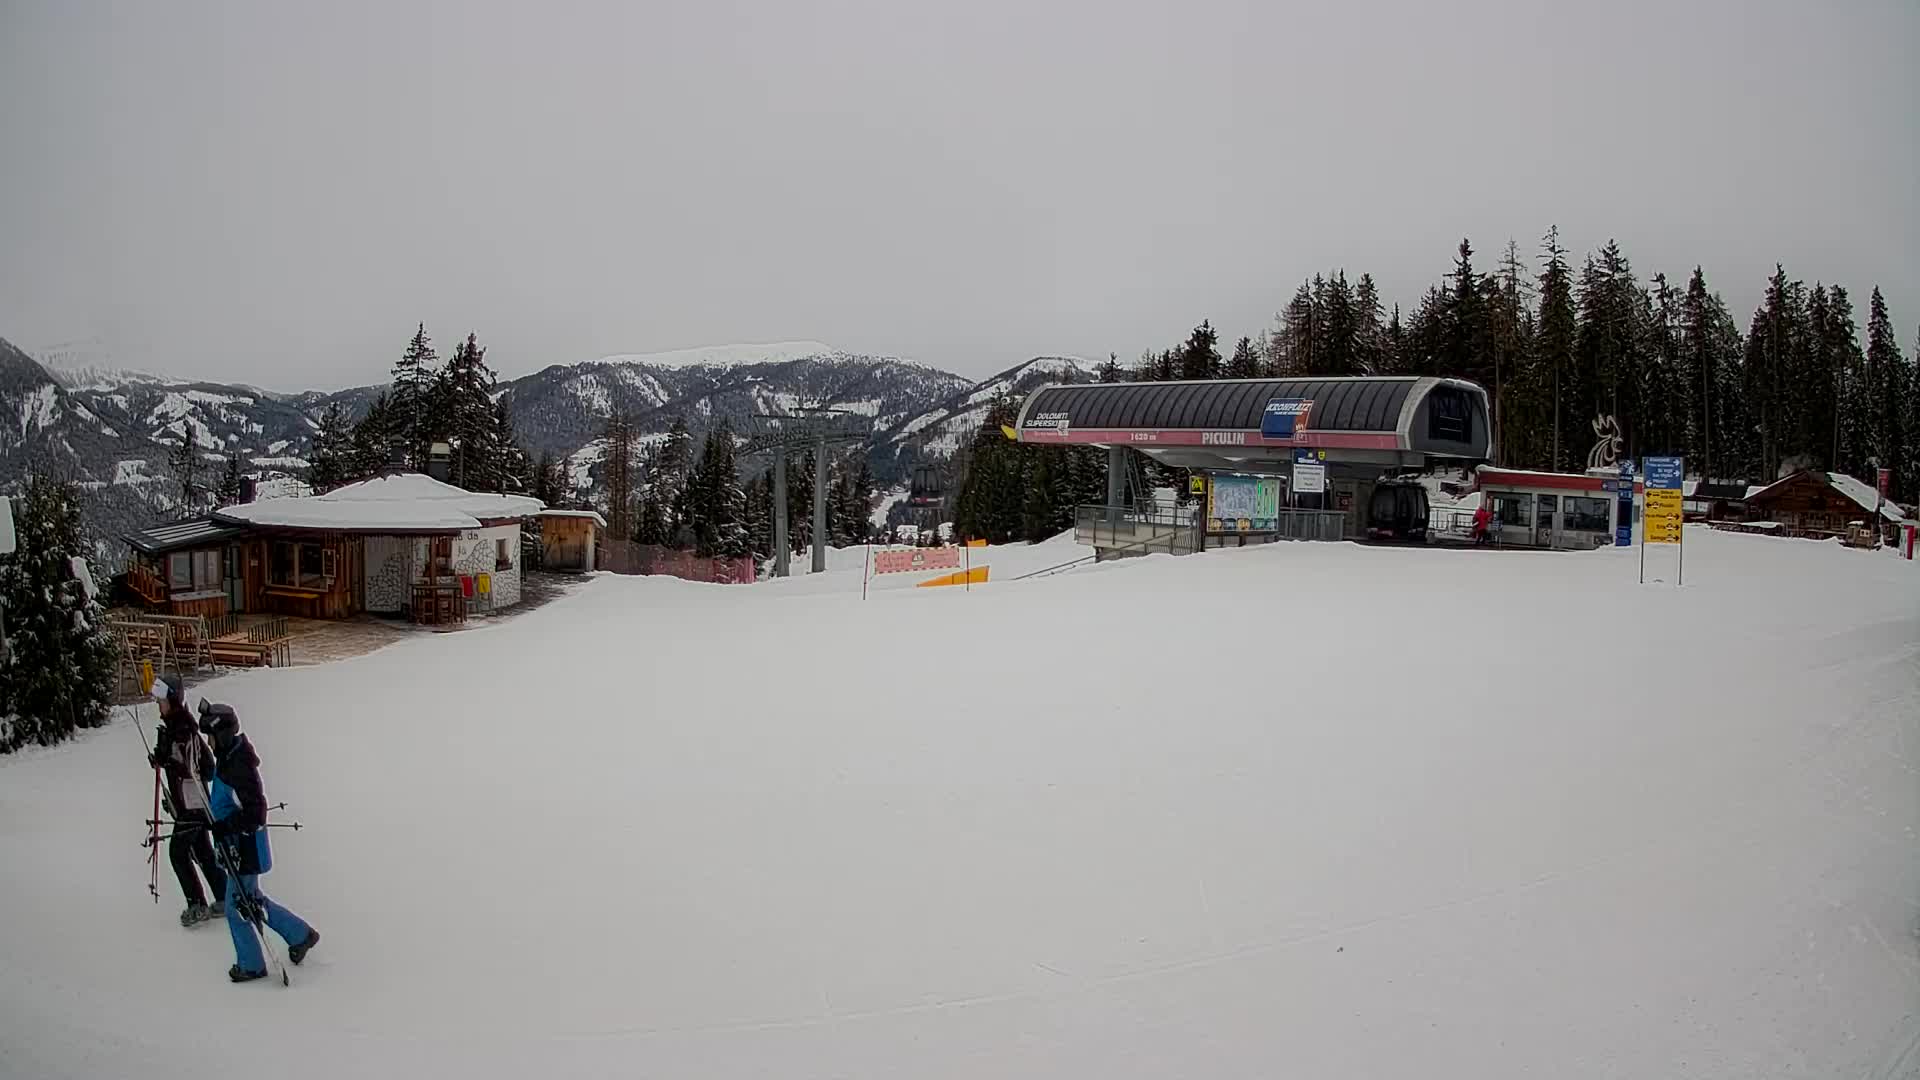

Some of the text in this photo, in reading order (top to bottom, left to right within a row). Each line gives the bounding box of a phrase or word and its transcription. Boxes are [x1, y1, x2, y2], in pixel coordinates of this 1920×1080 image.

[1266, 403, 1312, 411] KRONPLATZ
[1036, 412, 1069, 420] DOLOMITI
[1025, 419, 1058, 427] SUPERSKI
[1201, 432, 1245, 445] PICULIN
